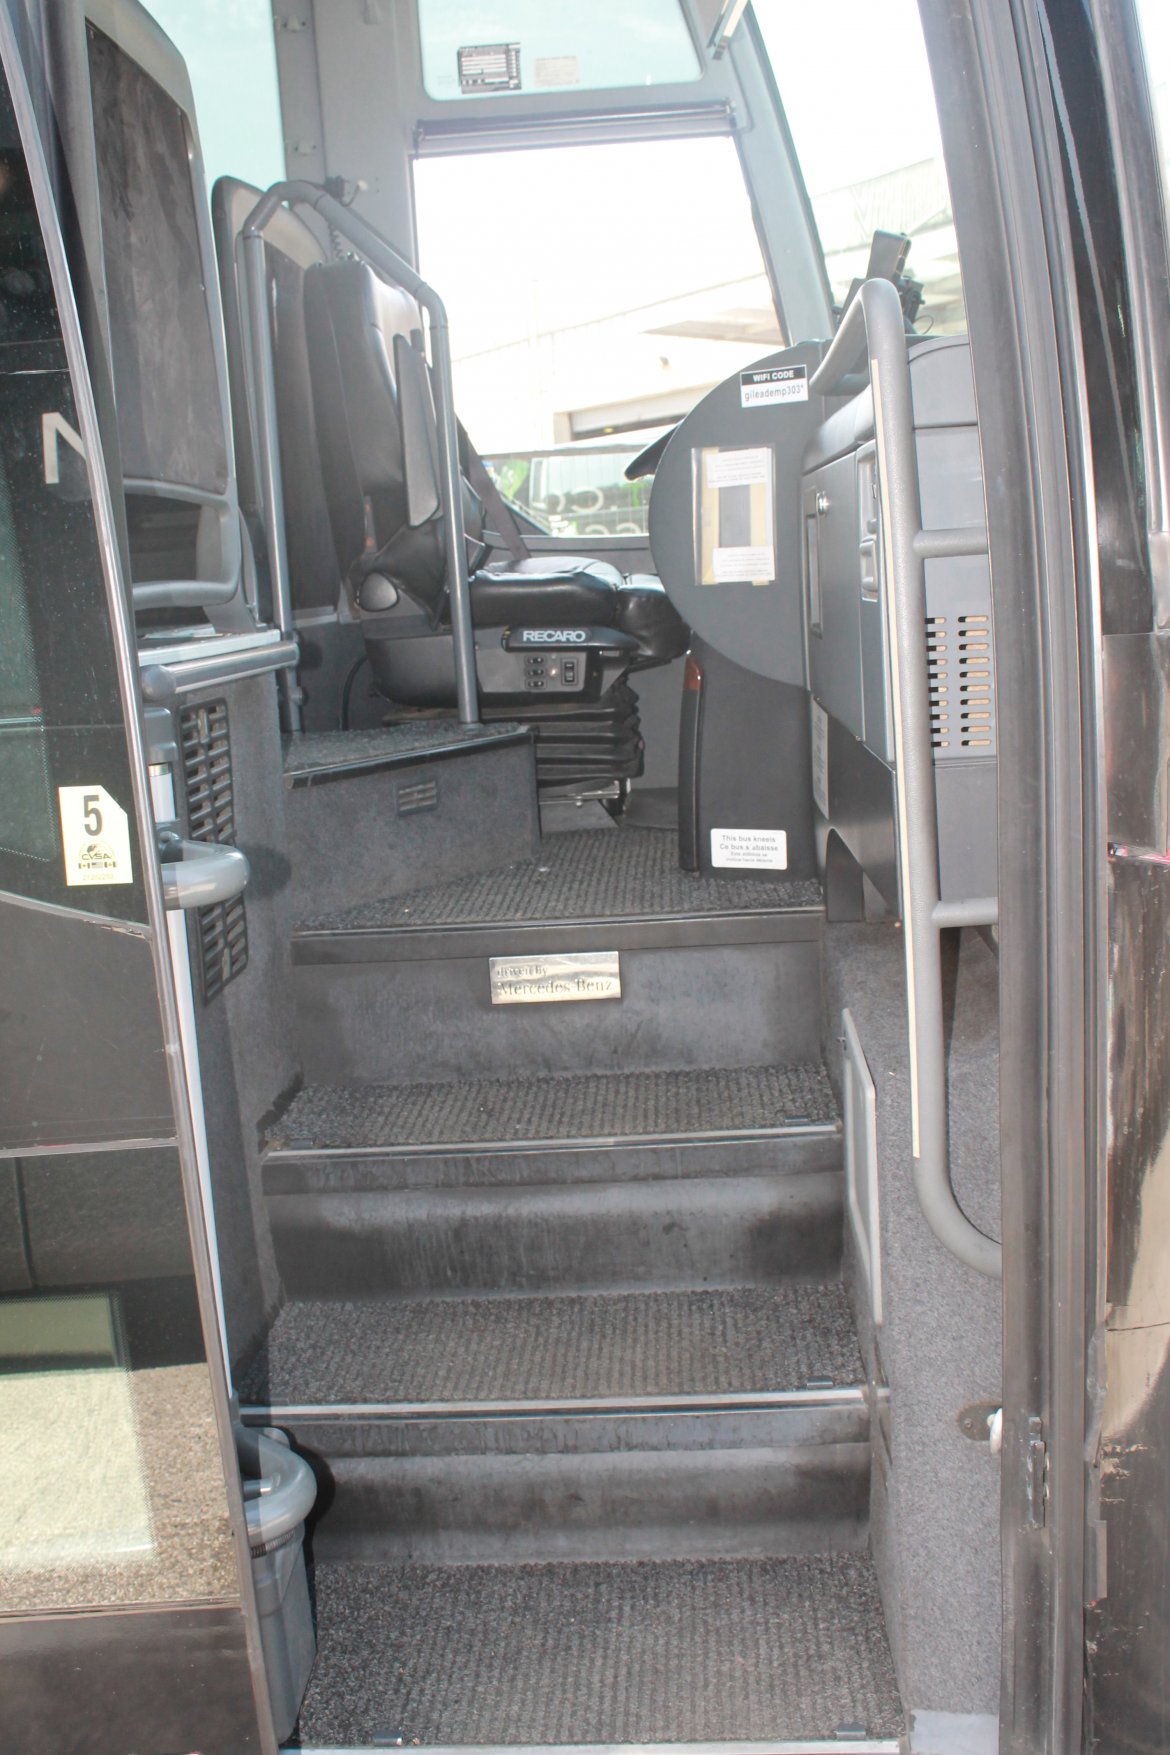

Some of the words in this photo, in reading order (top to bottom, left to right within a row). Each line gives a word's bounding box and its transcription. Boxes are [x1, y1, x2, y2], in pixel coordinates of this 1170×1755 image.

[753, 373, 770, 382] WIFI
[772, 370, 794, 380] CODE
[523, 630, 586, 642] RECARO
[83, 794, 103, 837] 5
[722, 834, 737, 842] This
[753, 835, 776, 843] kneels
[81, 853, 112, 861] CVSA
[497, 964, 533, 978] driven
[535, 964, 549, 977] by
